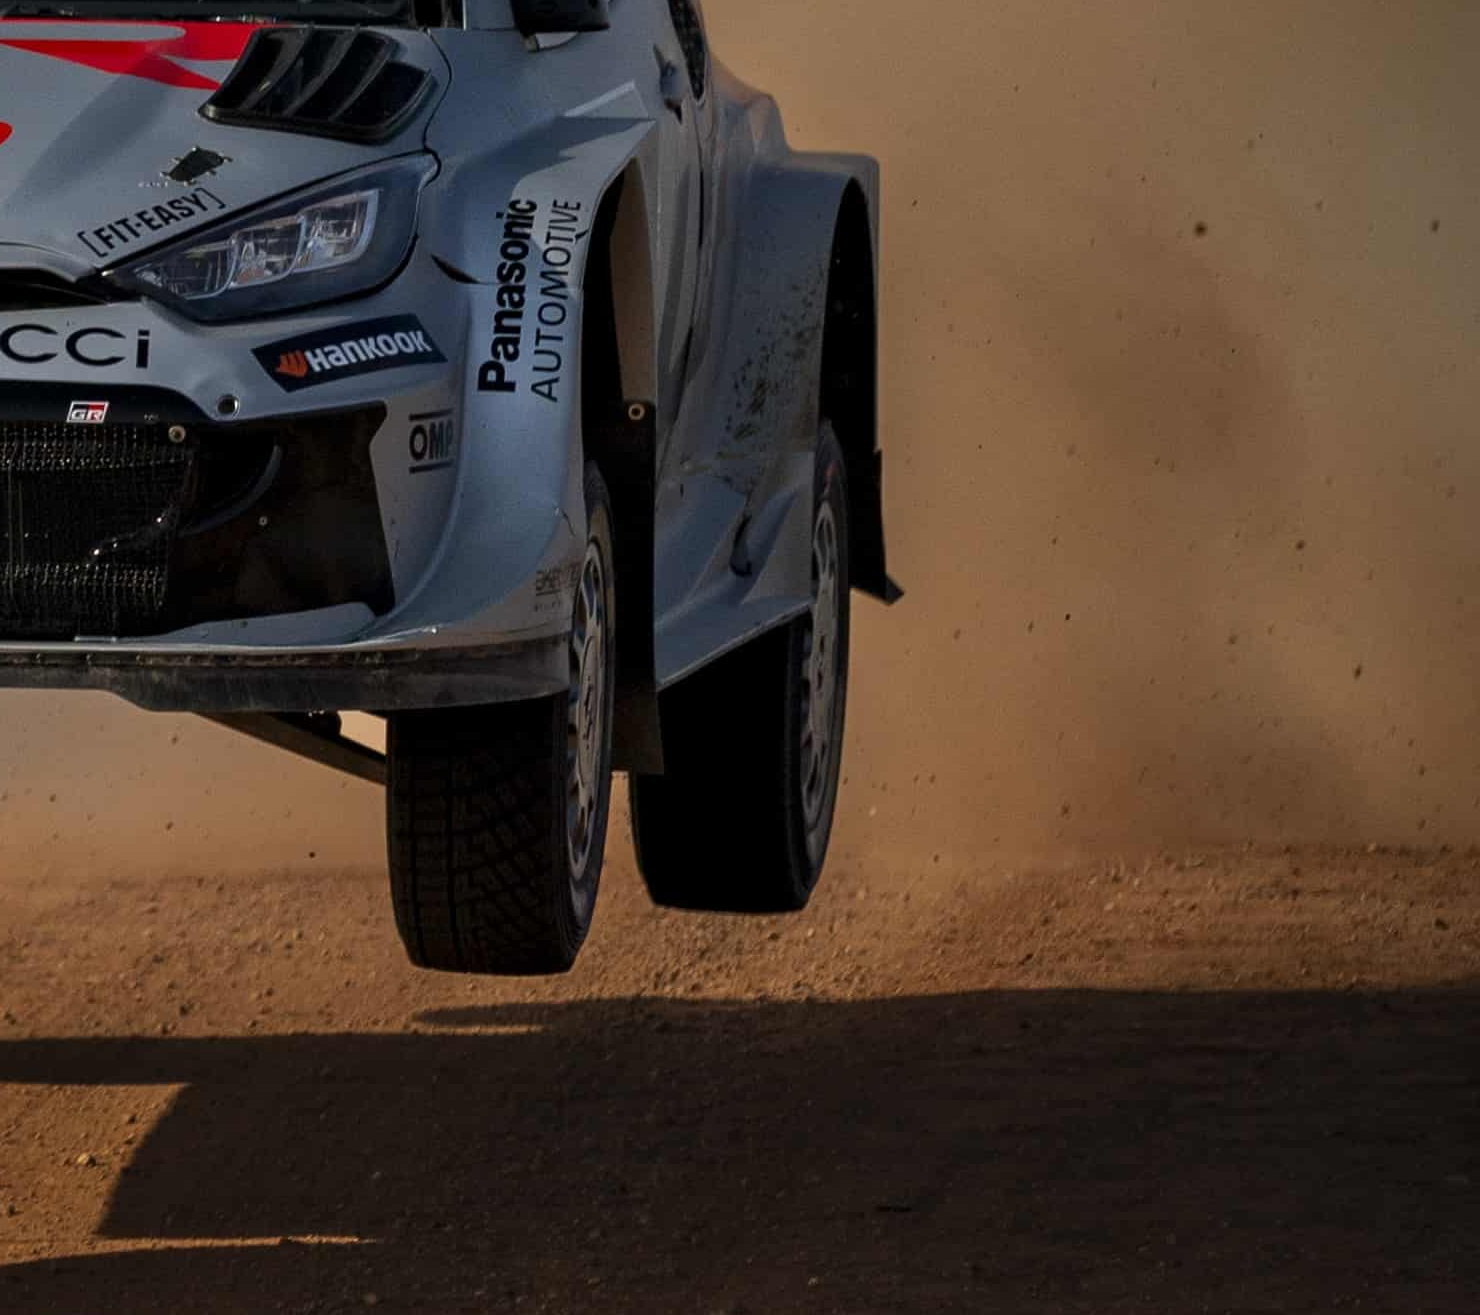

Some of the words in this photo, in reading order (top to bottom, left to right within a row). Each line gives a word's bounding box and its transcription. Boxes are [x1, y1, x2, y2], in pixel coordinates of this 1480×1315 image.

[477, 199, 538, 393] Panasonic
[530, 199, 581, 403] AUTOMOTIVE
[69, 407, 106, 422] GR
[409, 420, 454, 462] OMP
